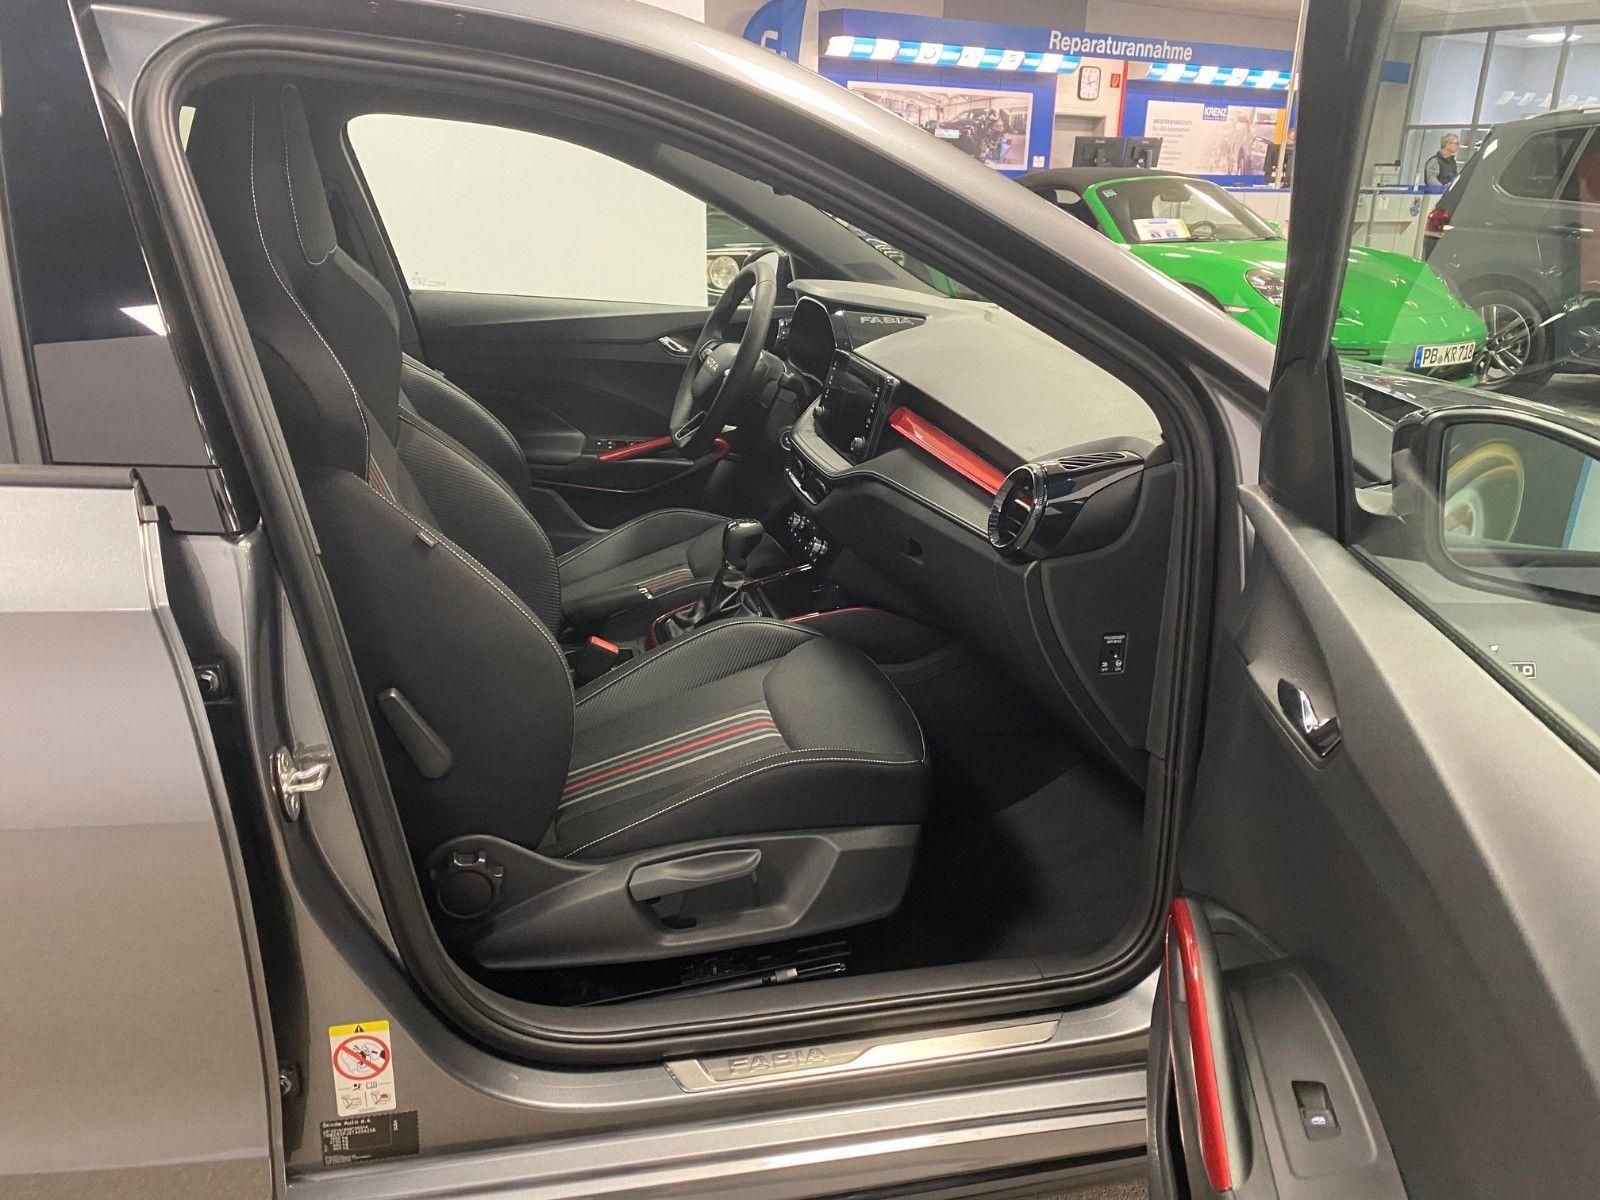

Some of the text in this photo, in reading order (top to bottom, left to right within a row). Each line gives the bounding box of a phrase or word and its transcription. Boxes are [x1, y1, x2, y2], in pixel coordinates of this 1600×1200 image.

[1049, 30, 1193, 61] Reparaturannahme
[1204, 106, 1228, 117] KRENZ
[861, 316, 913, 325] FABIA
[1423, 348, 1439, 364] PB
[1444, 346, 1457, 363] KR
[728, 1048, 830, 1075] FABIA
